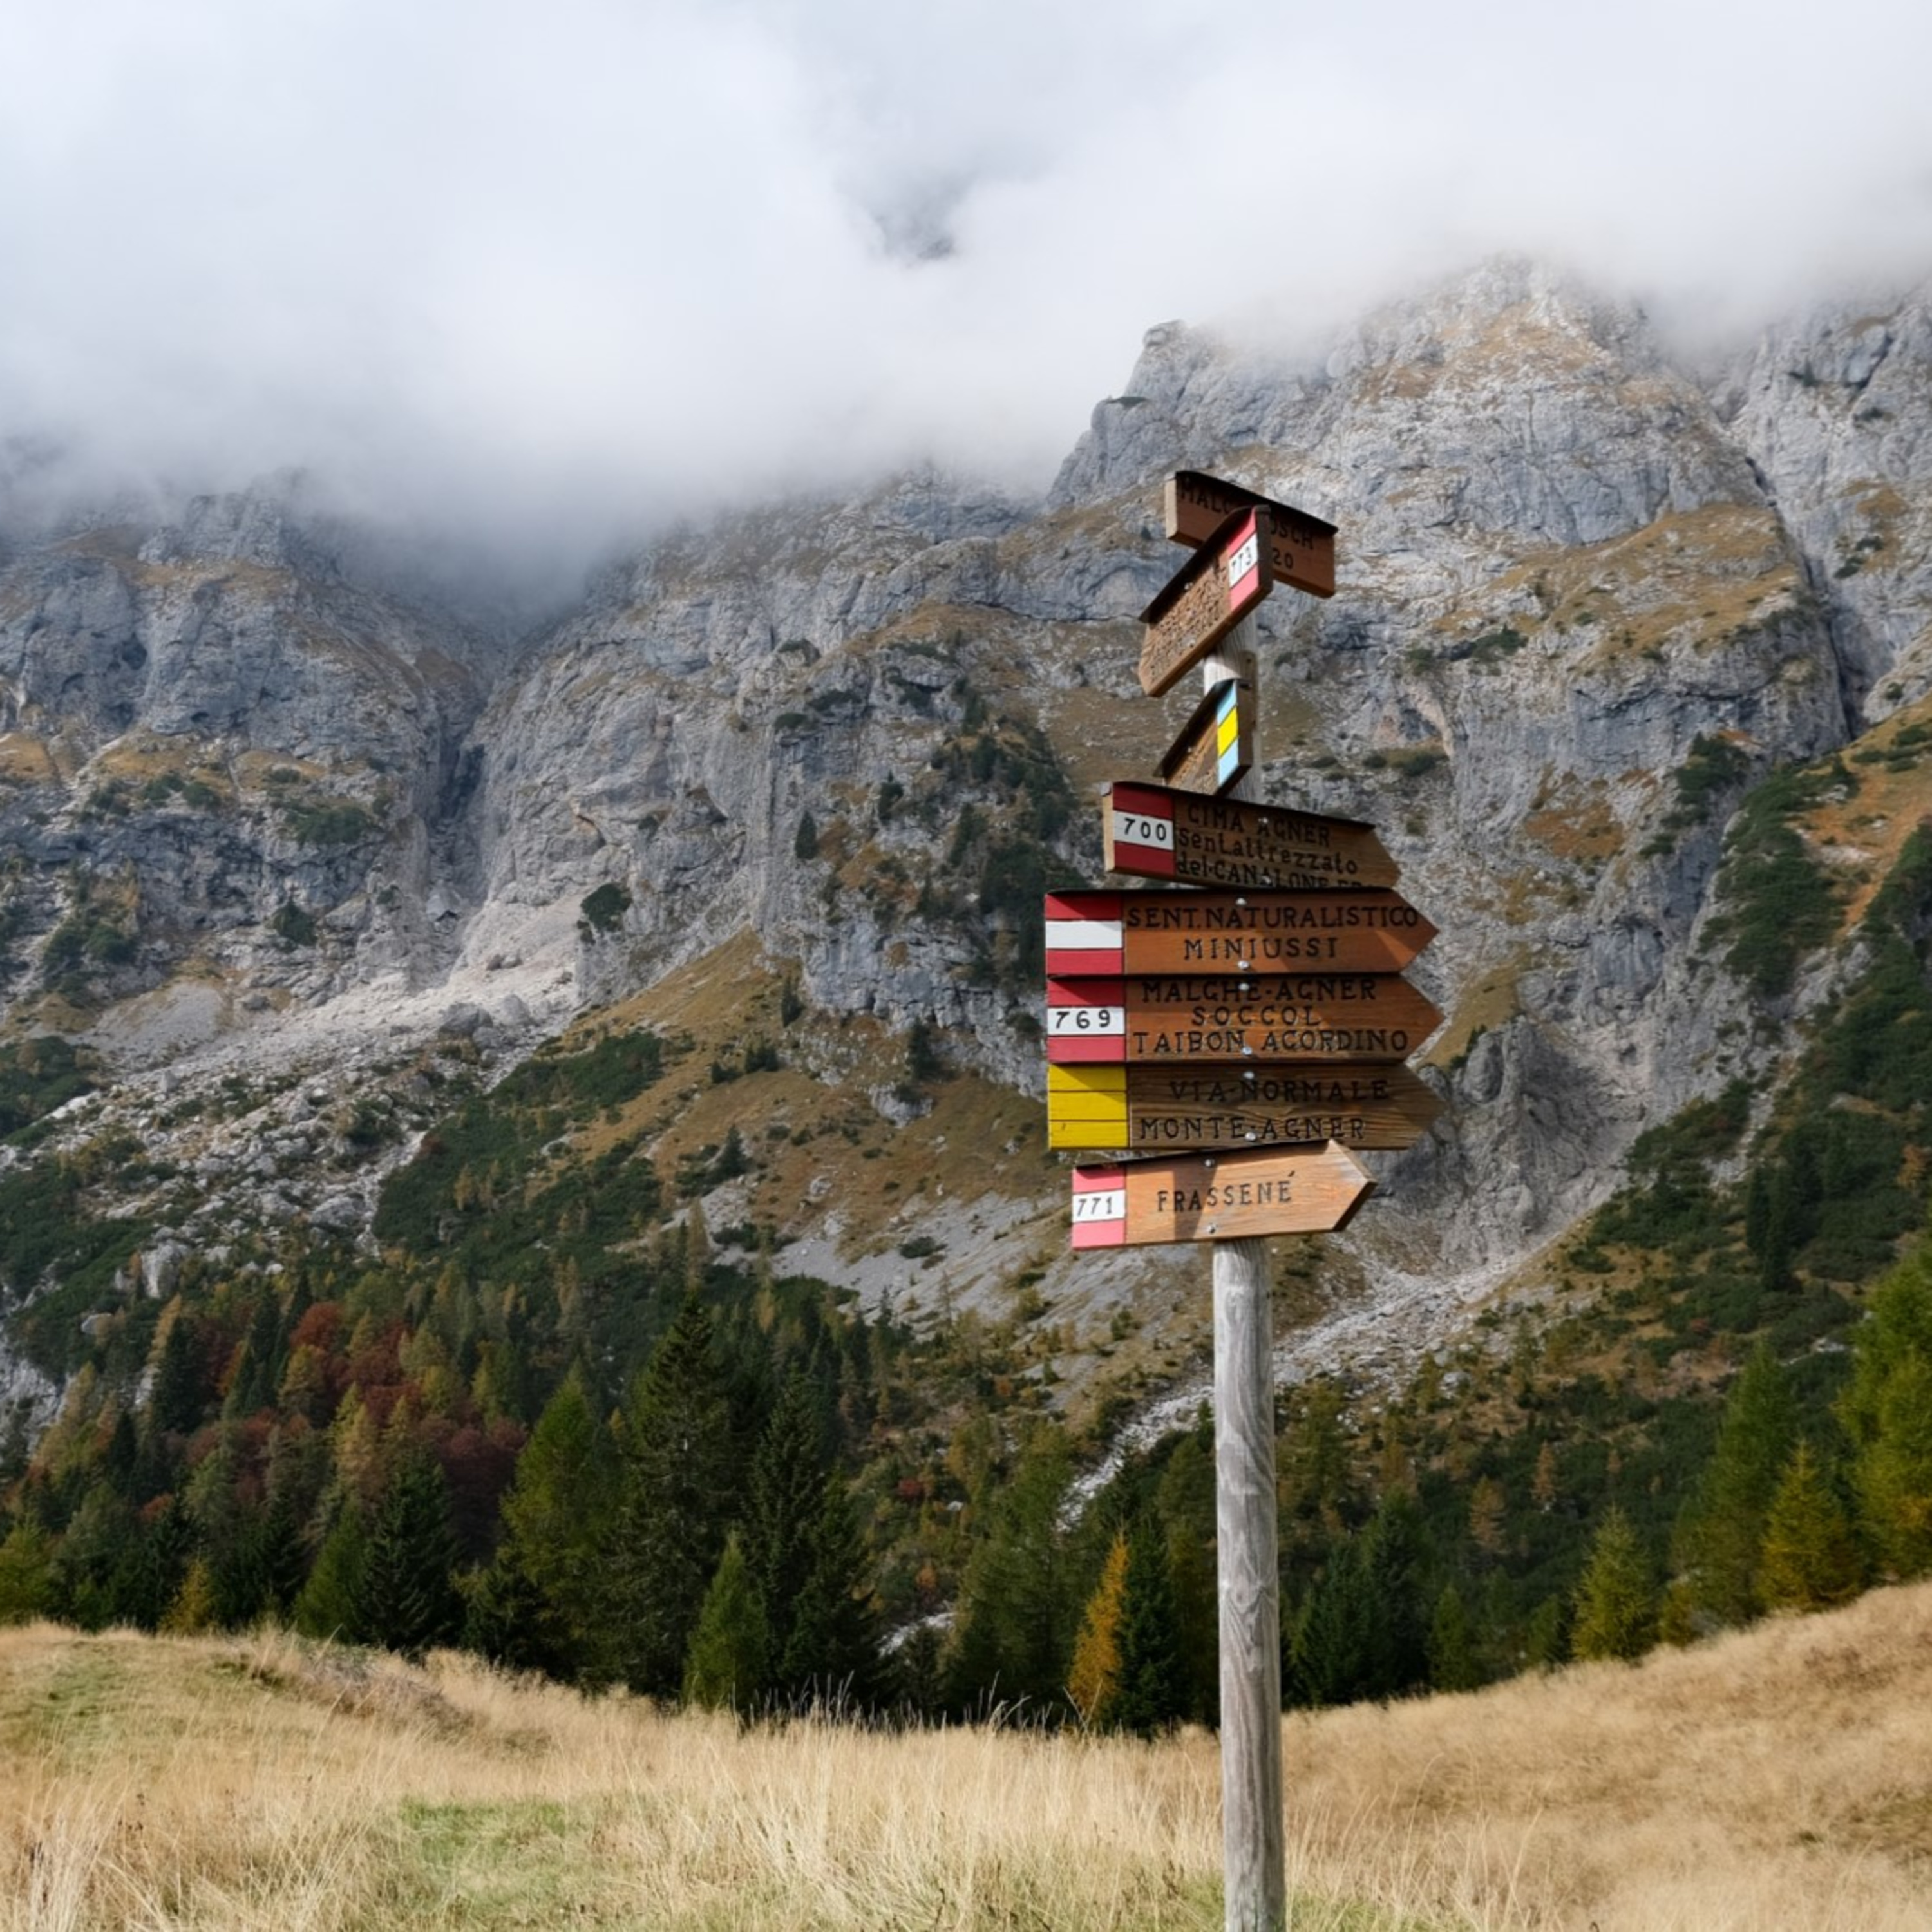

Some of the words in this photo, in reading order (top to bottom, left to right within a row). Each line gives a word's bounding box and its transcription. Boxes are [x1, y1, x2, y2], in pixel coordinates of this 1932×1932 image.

[1124, 818, 1166, 841] 700
[1188, 803, 1244, 833] CIMA
[1258, 817, 1331, 848] AGNER
[1184, 937, 1338, 960] MINIUSSI
[1056, 1009, 1110, 1029] 769
[1191, 1005, 1321, 1027] SOCCOL
[1133, 1030, 1245, 1053] TAIBON
[1077, 1197, 1112, 1217] 771
